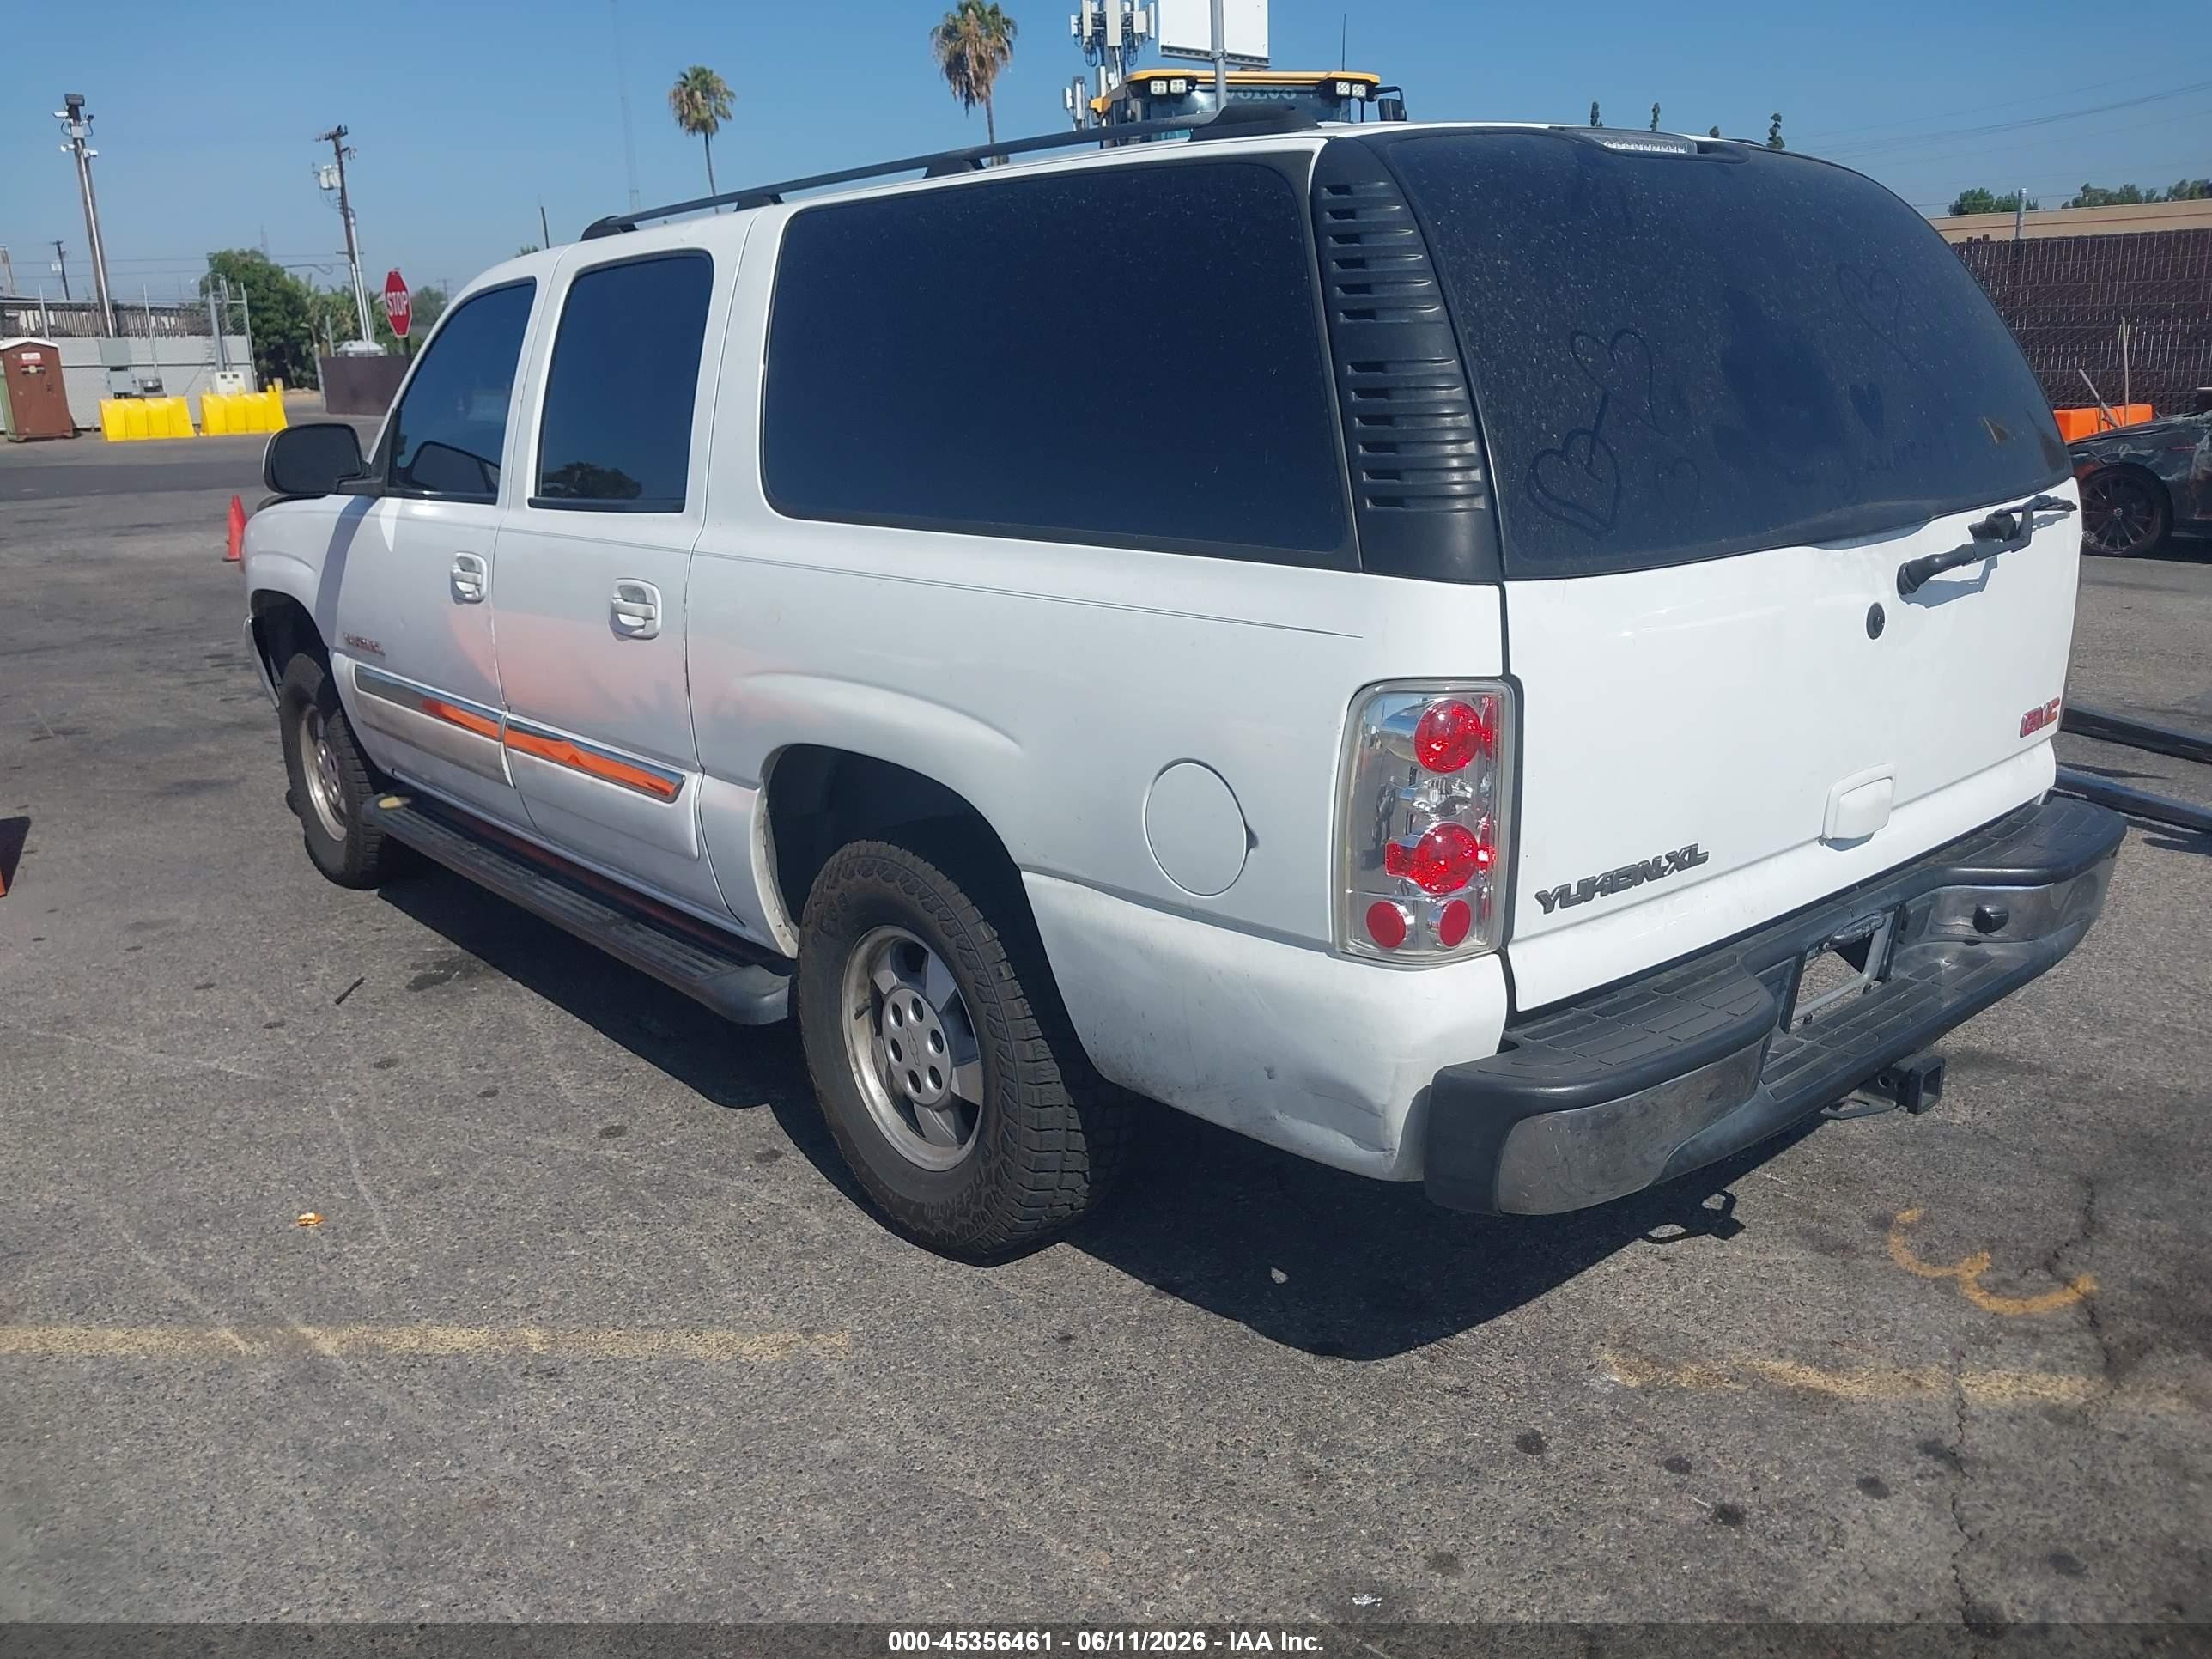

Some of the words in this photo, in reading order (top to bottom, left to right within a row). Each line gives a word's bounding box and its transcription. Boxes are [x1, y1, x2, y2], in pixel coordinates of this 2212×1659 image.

[386, 291, 408, 317] STOP
[2019, 696, 2061, 738] GMC
[1534, 855, 1663, 915] YUKON
